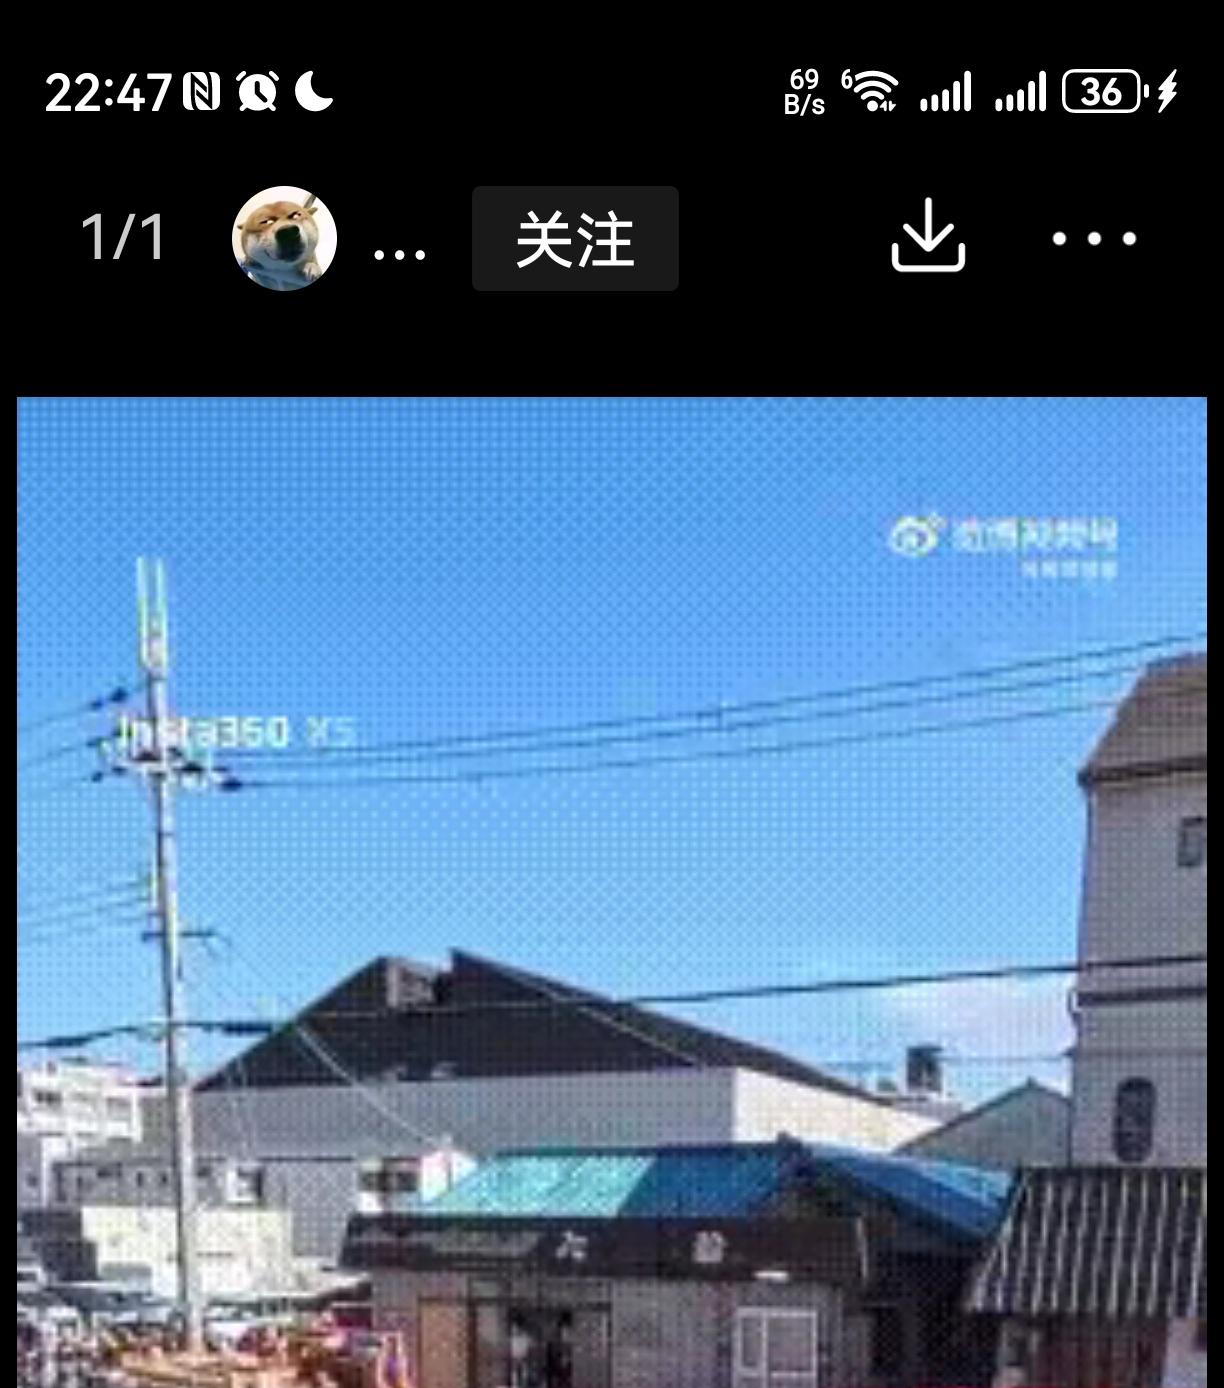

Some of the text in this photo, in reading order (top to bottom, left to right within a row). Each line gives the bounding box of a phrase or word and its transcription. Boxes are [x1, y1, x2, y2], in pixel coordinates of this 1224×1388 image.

[46, 73, 173, 111] 22:47
[790, 68, 818, 90] 69
[841, 69, 853, 89] 6
[1081, 78, 1122, 106] 36
[785, 94, 825, 117] B/s
[83, 214, 160, 259] 1/1
[517, 210, 634, 268] 关注
